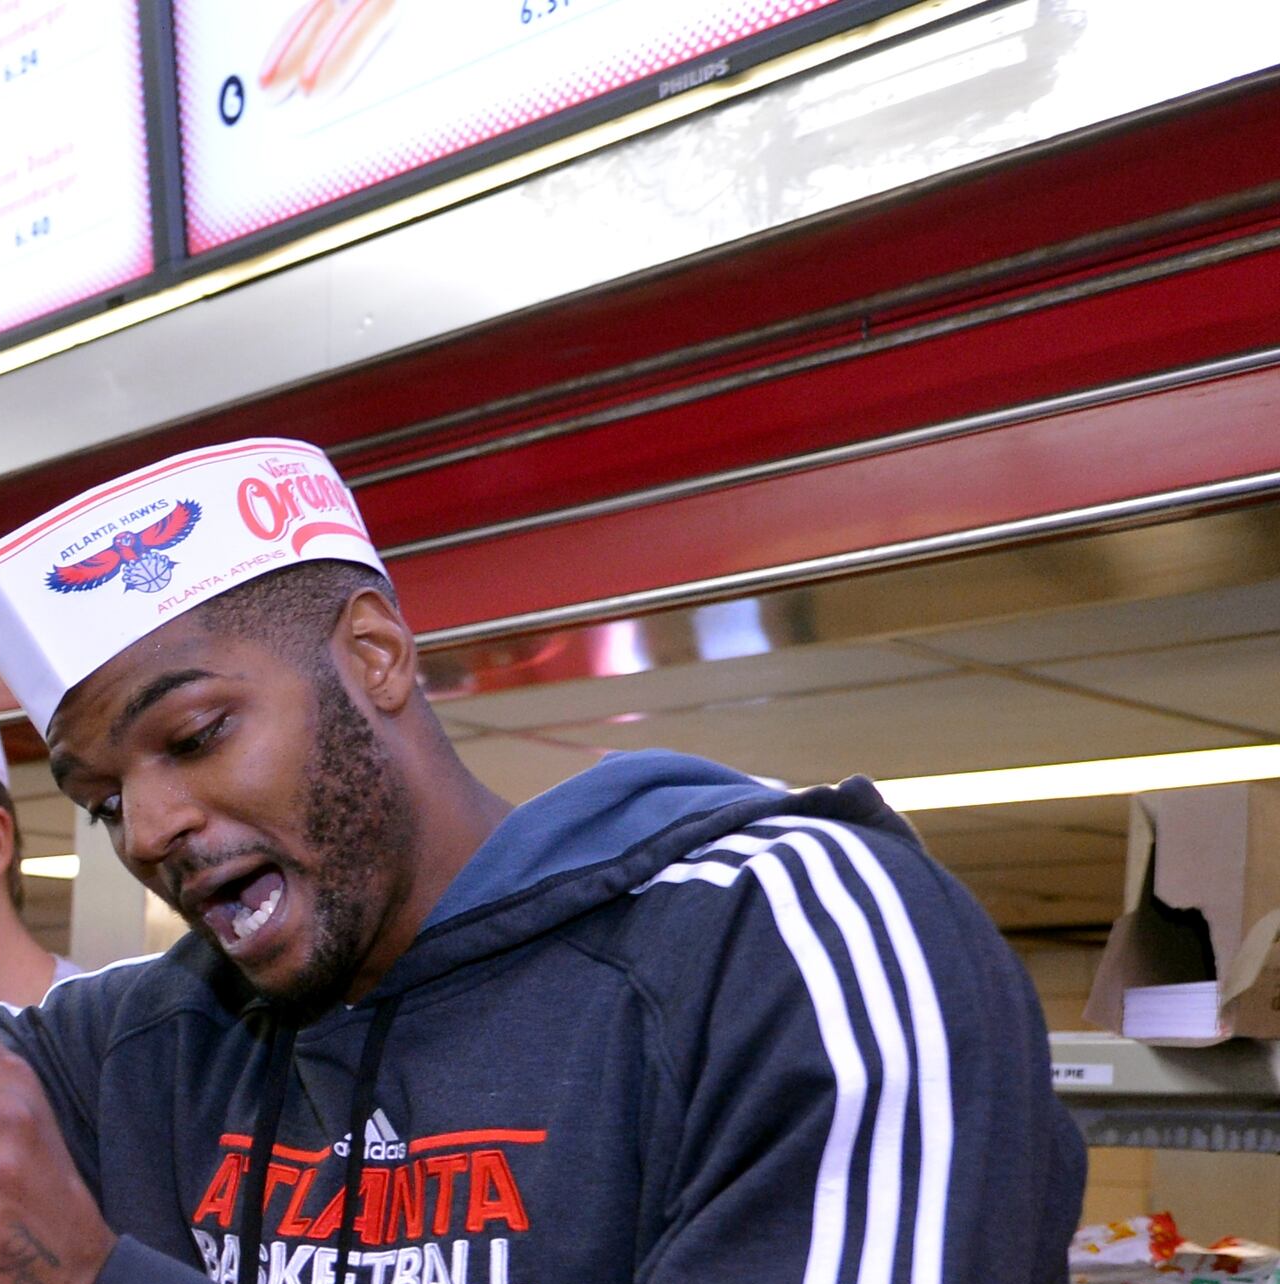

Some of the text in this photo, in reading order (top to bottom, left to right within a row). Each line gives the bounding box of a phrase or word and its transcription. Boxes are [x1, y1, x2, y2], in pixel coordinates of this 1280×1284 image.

[657, 57, 730, 99] PHILIPS
[60, 498, 170, 561] ATLANTA HAWKS
[157, 549, 288, 615] ATLANTA ATHENS
[333, 1140, 407, 1160] aidas
[192, 1149, 531, 1247] ATLANTA
